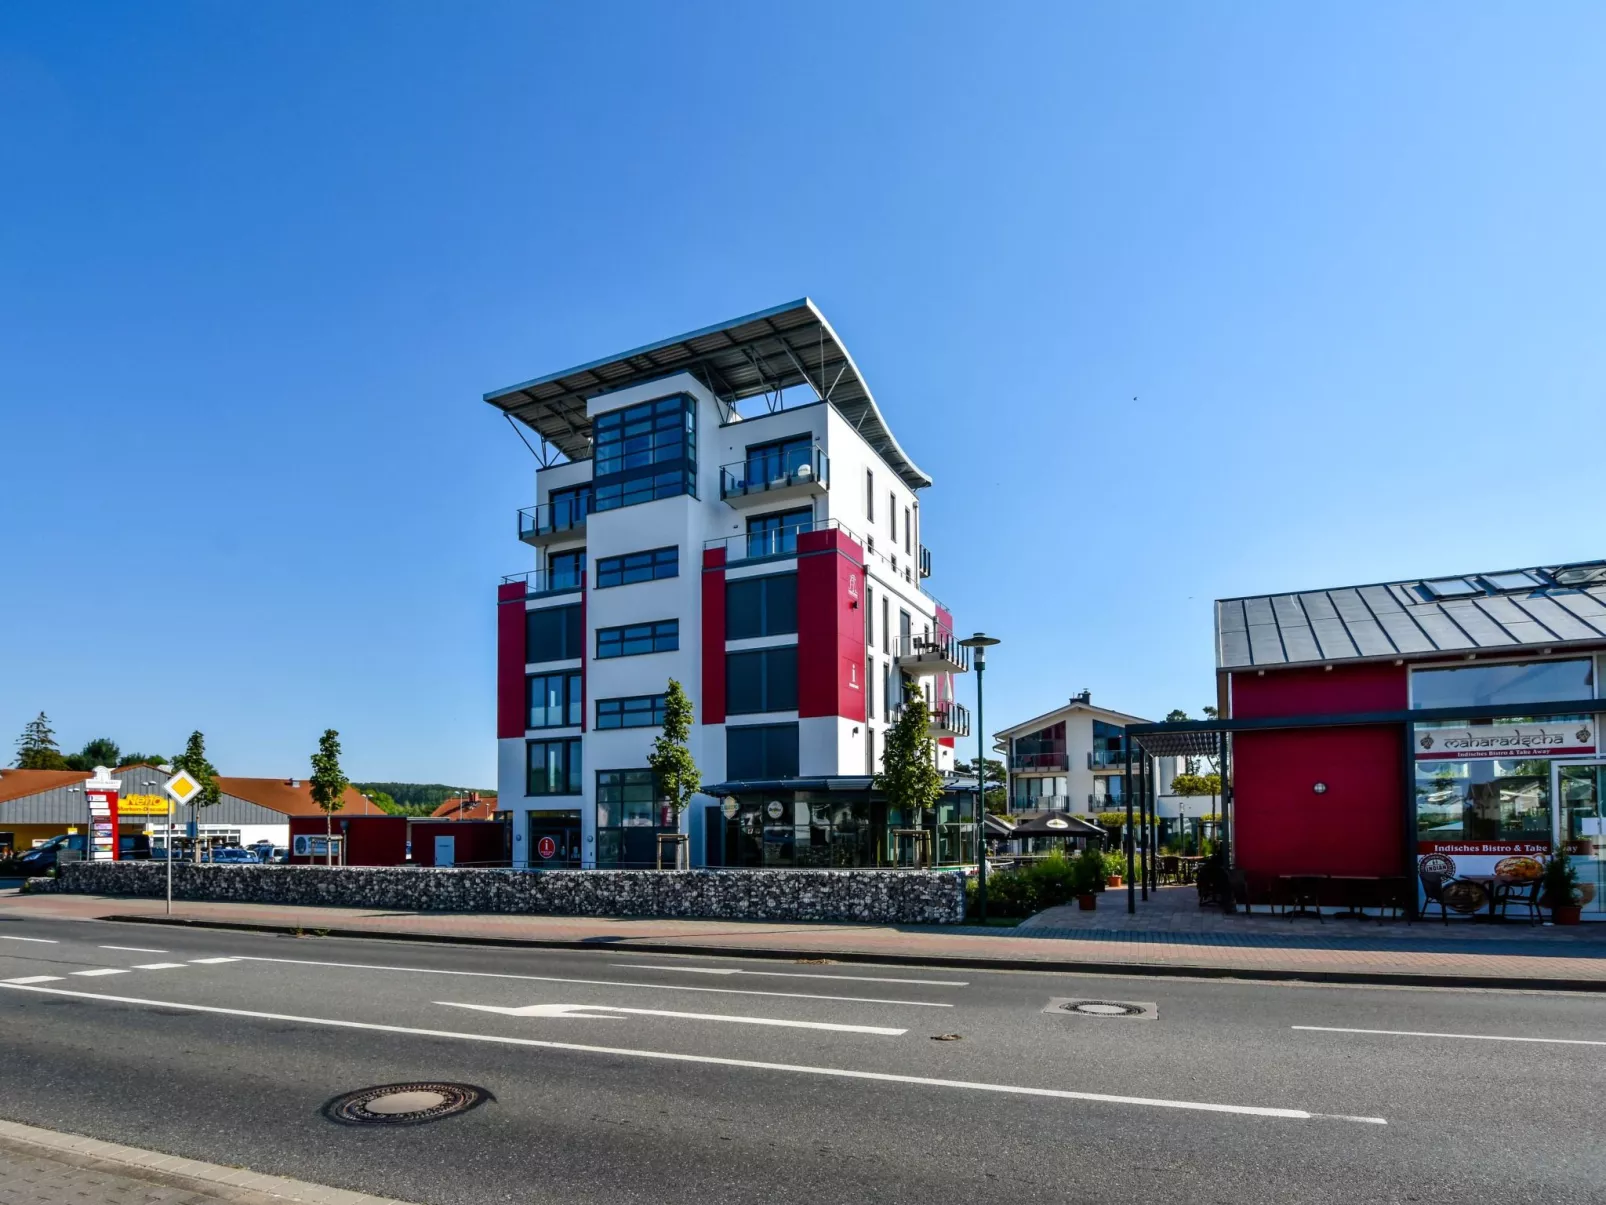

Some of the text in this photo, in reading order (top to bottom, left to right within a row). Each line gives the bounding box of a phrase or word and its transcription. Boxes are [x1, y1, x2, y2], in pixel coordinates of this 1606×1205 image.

[1444, 729, 1564, 748] maharadscha
[1434, 844, 1480, 852] Indisches
[1482, 844, 1511, 852] Bistro
[1513, 844, 1521, 852] &
[1524, 844, 1548, 852] Take
